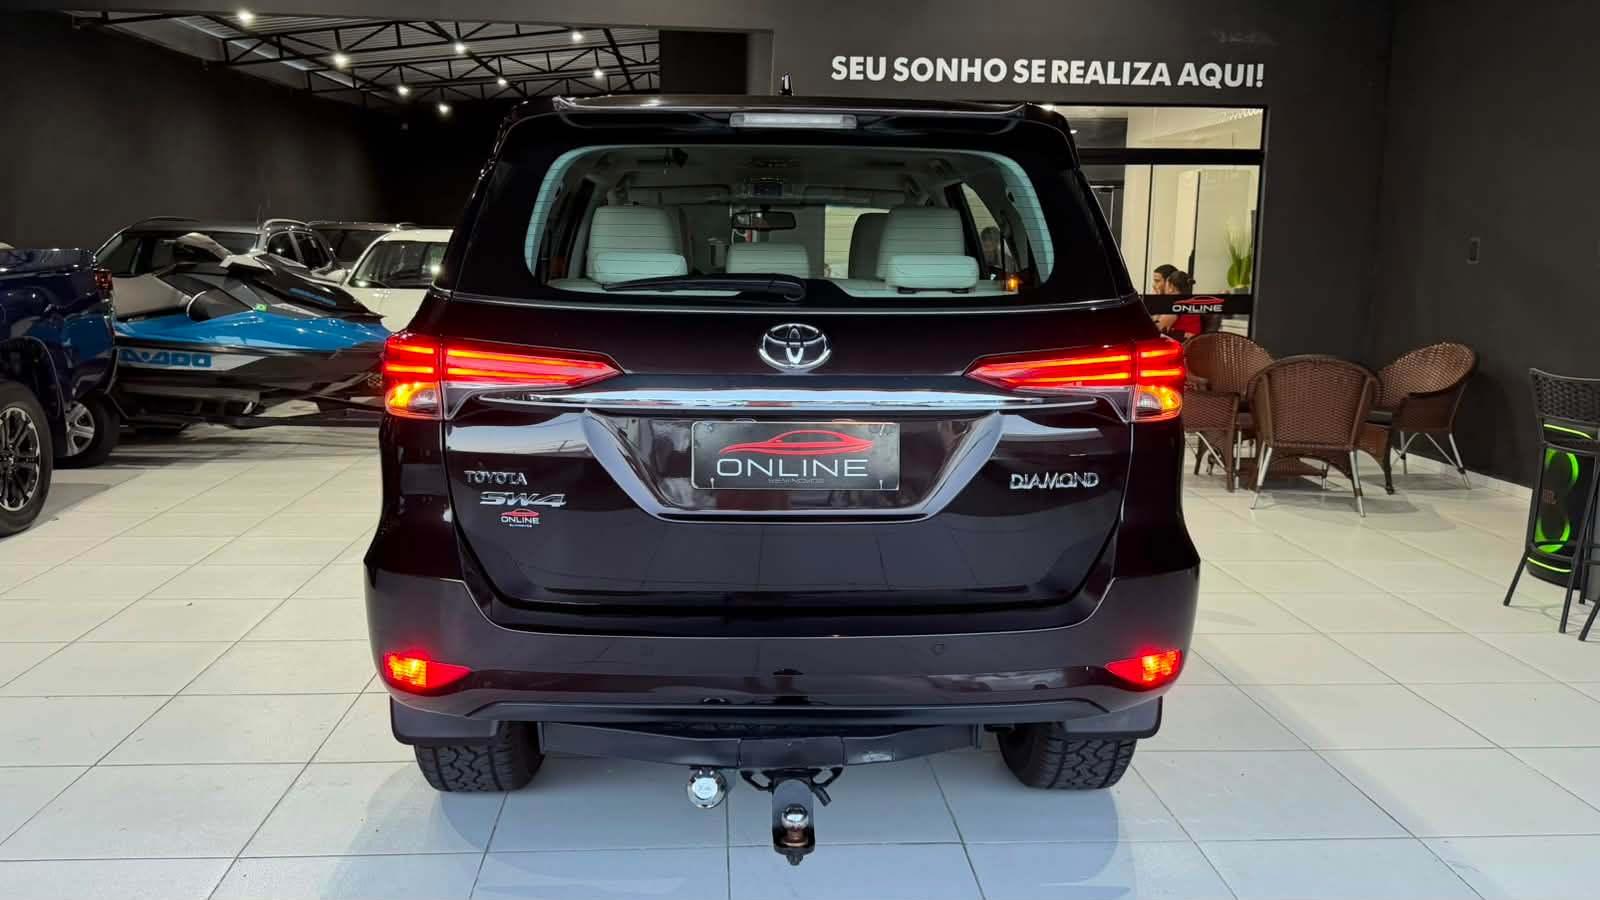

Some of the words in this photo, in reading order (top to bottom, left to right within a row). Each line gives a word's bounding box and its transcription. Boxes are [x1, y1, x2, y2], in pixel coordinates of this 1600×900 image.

[831, 56, 887, 81] SEU
[893, 57, 1007, 82] SONHO
[1013, 59, 1046, 83] SE
[1051, 60, 1172, 86] REALIZA
[1177, 62, 1264, 88] AQUI!
[1172, 304, 1223, 312] ONLINE
[716, 458, 869, 477] ONLINE
[464, 470, 528, 485] TOYOTA
[1009, 472, 1099, 490] DIAMOND
[480, 491, 567, 507] SW4
[501, 516, 540, 524] ONLINE
